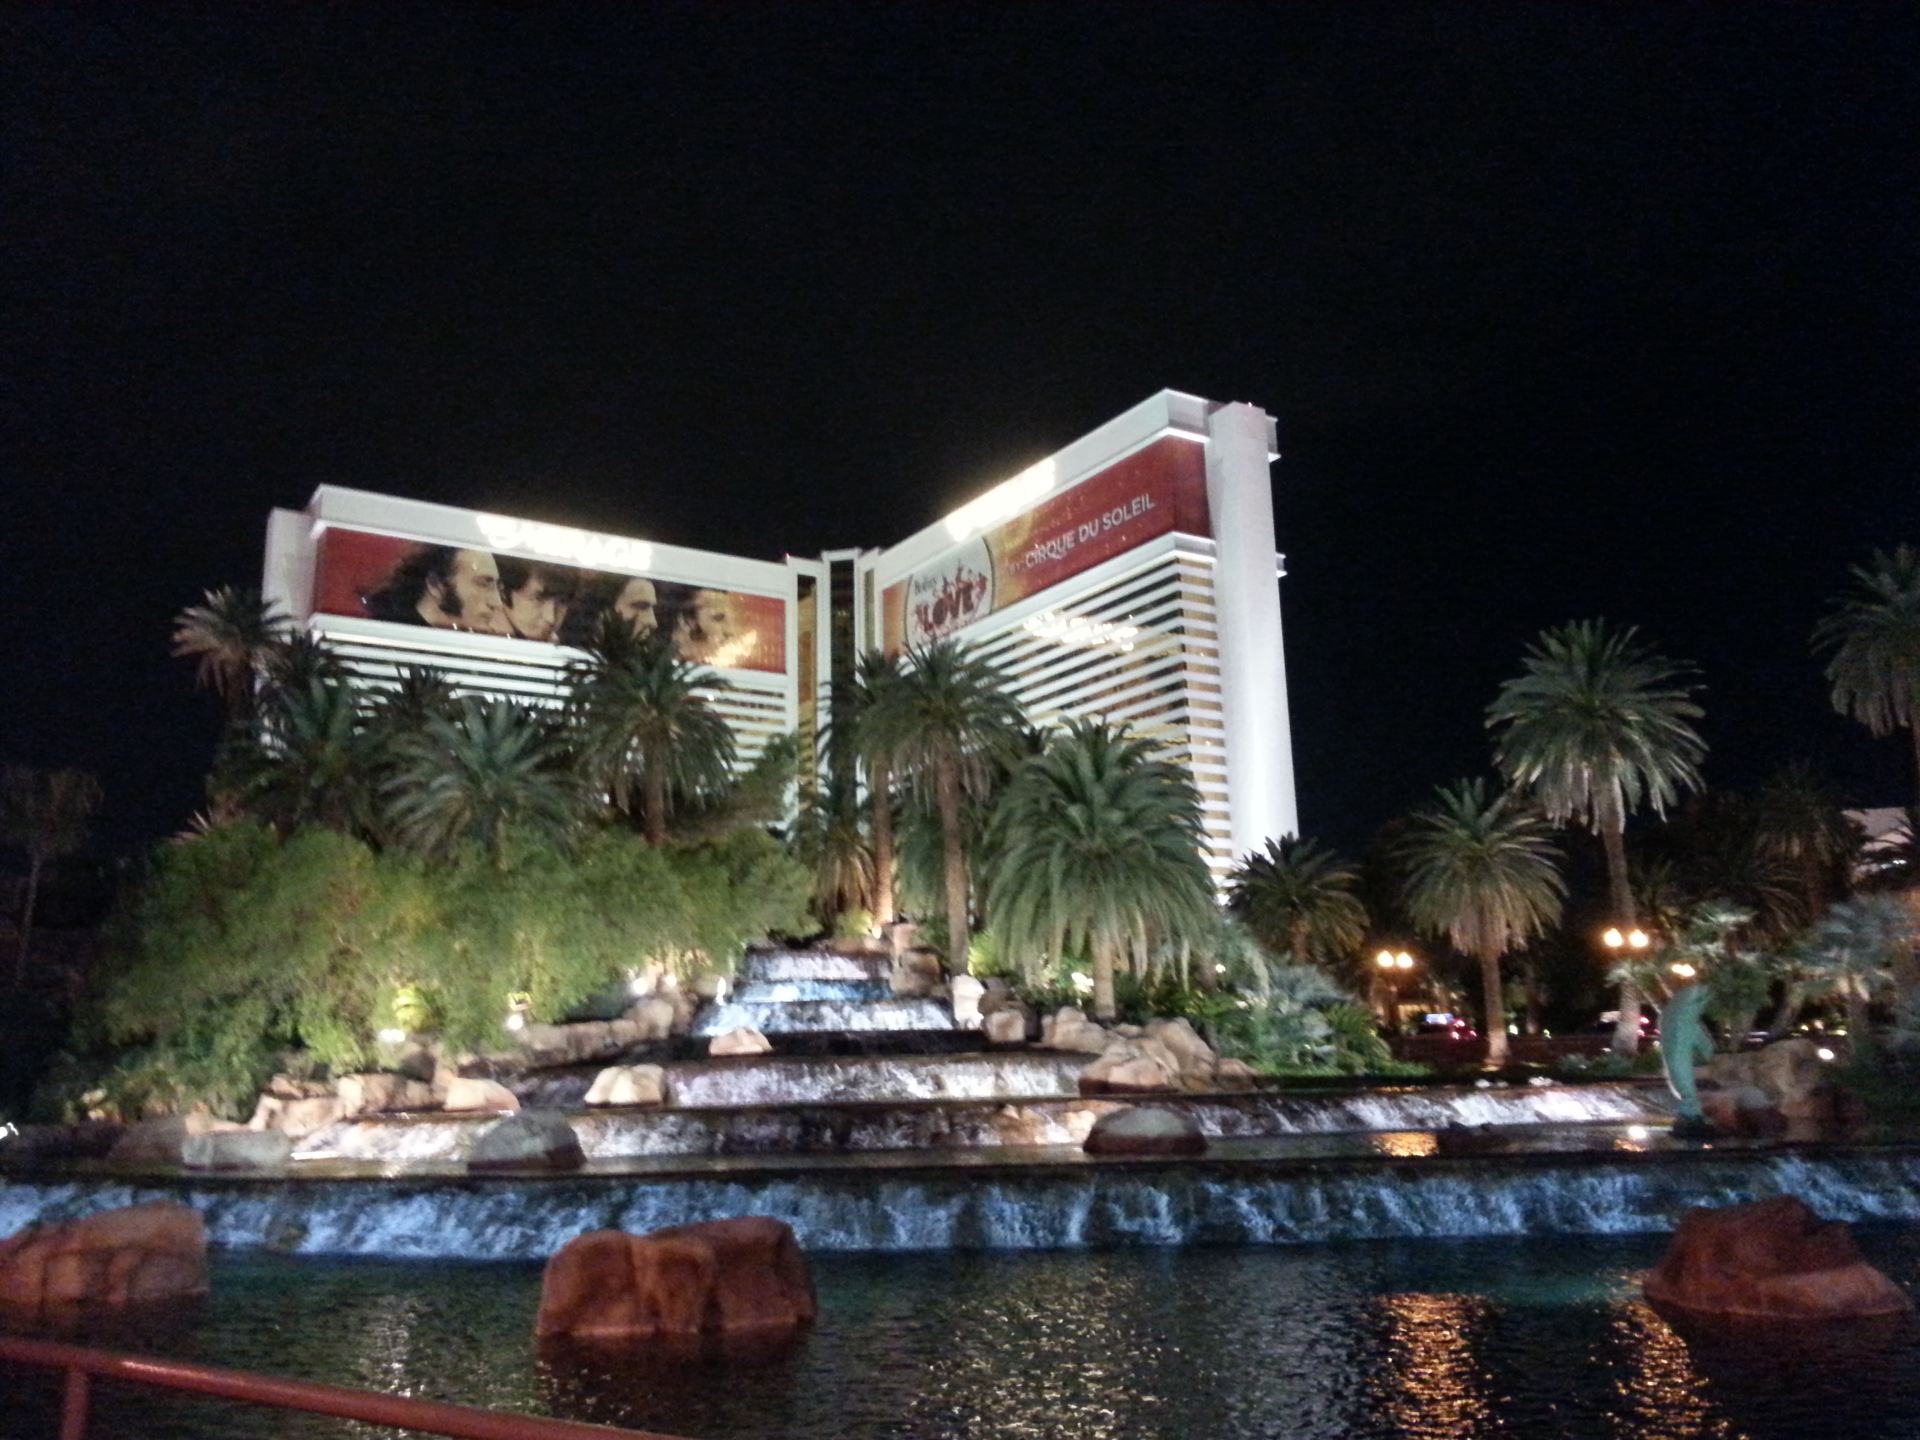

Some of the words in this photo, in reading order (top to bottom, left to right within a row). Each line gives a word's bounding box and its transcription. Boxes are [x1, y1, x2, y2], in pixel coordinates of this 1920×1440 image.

[1025, 531, 1075, 568] CIRQUE
[1078, 518, 1100, 543] DU
[1102, 493, 1156, 530] SOLEIL
